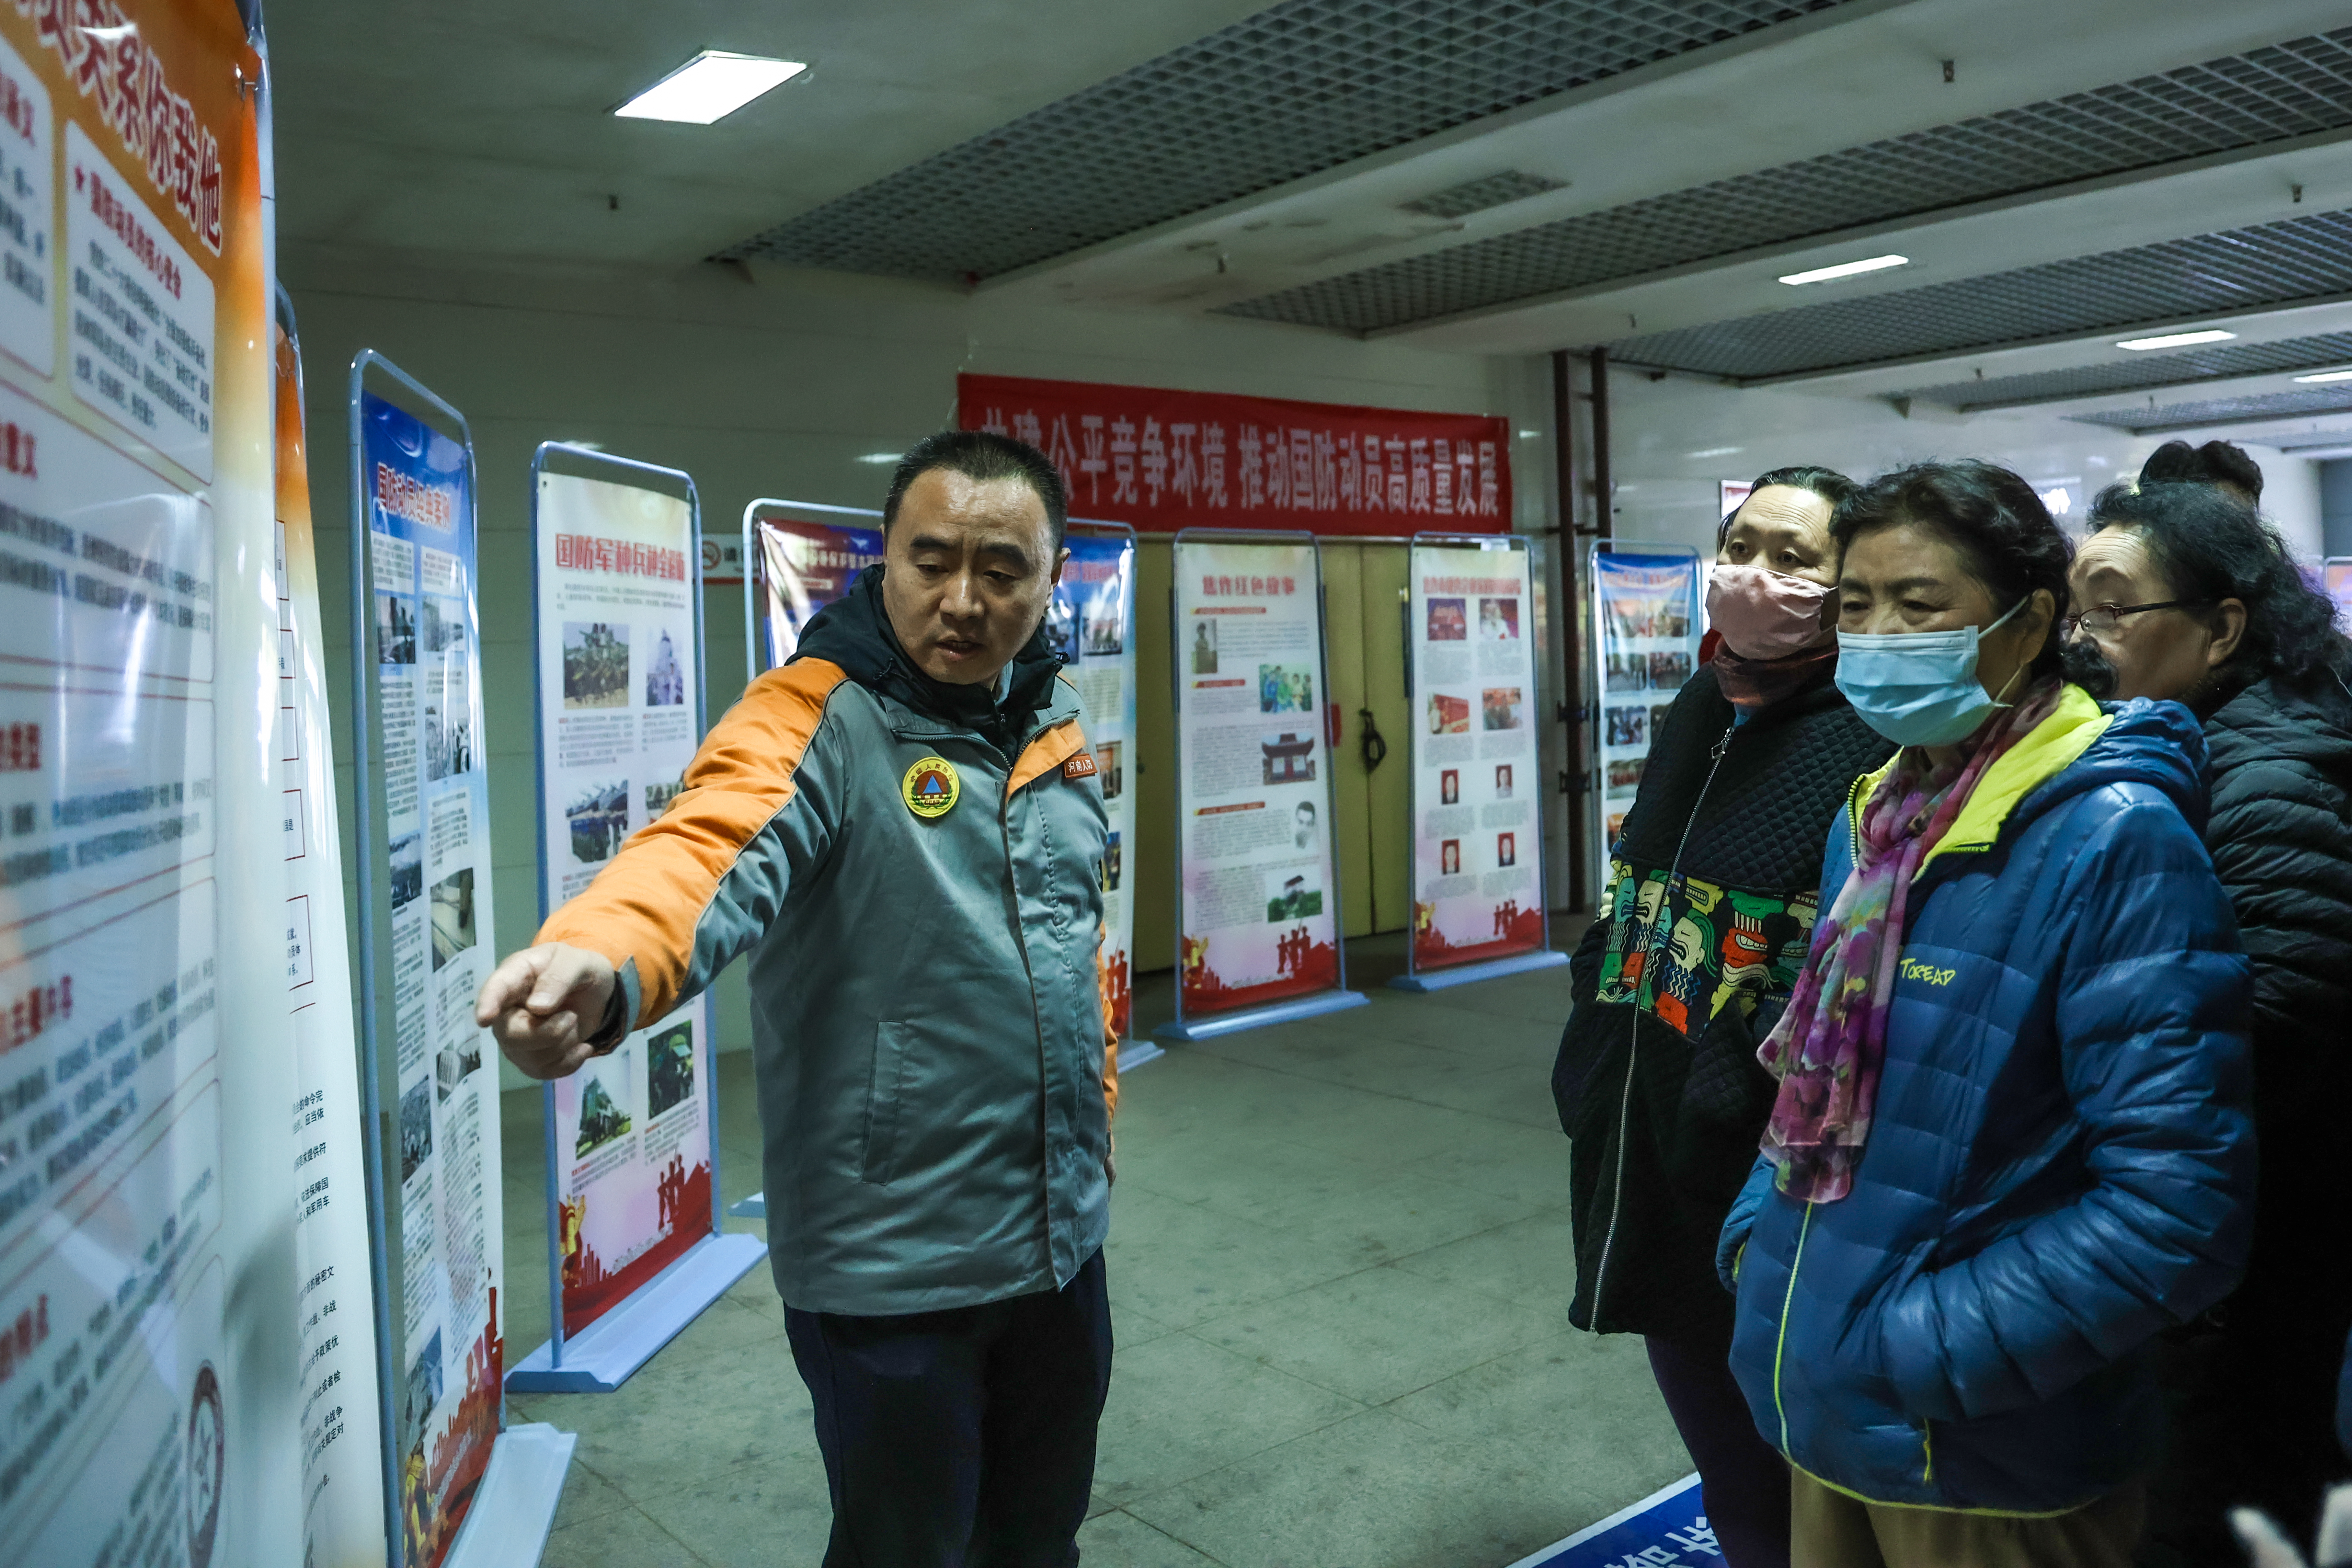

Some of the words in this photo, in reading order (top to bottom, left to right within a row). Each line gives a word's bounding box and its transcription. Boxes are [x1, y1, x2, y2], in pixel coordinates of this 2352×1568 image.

[1238, 423, 1498, 517] 推动国防动员高质量发展
[910, 763, 954, 782] 中国人民防空
[1068, 759, 1093, 773] 河南人防
[1900, 958, 1956, 986] TOREAD
